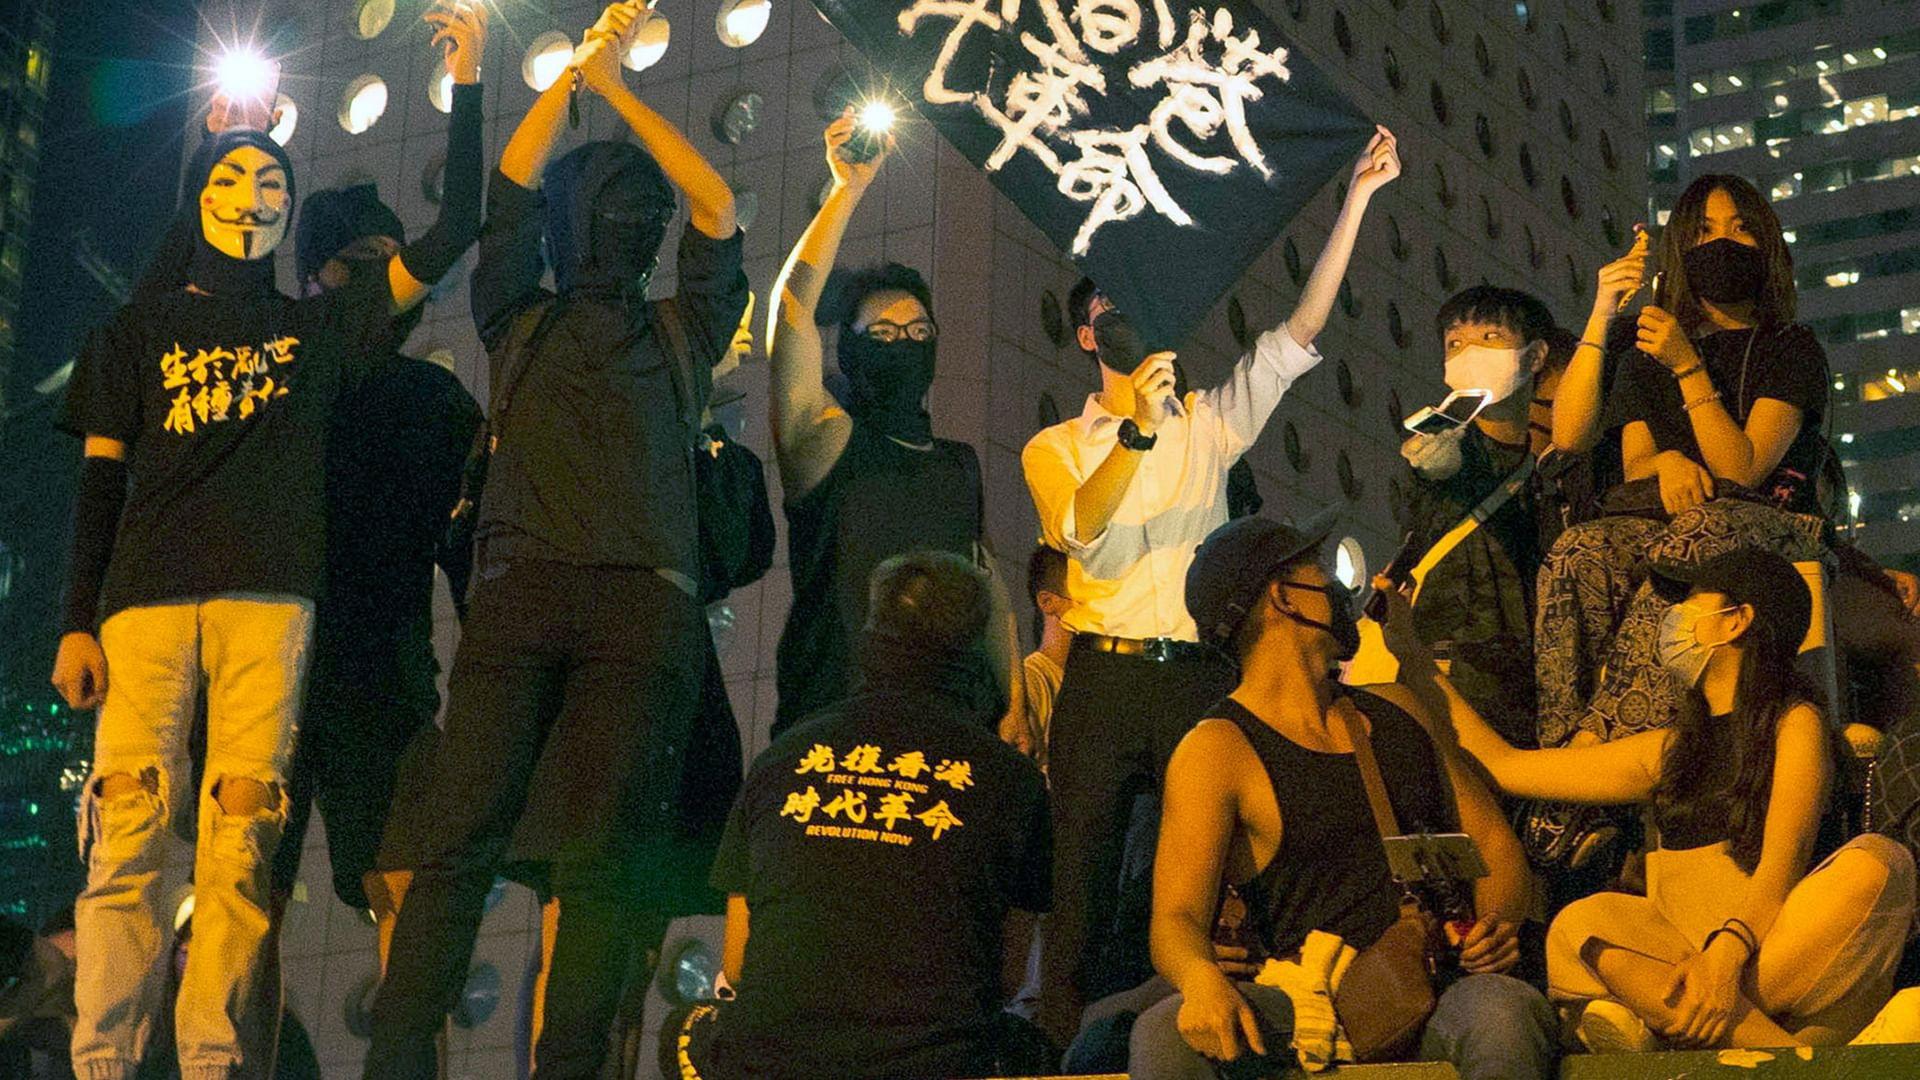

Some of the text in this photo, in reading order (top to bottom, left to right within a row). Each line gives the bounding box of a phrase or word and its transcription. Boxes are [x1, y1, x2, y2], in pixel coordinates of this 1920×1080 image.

[160, 335, 300, 390] 生於亂世
[796, 743, 975, 791] 光復香港
[826, 774, 930, 794] FREE HONG KONG
[781, 786, 964, 840] 時代革命
[805, 825, 913, 846] REVOLUTION NOW
